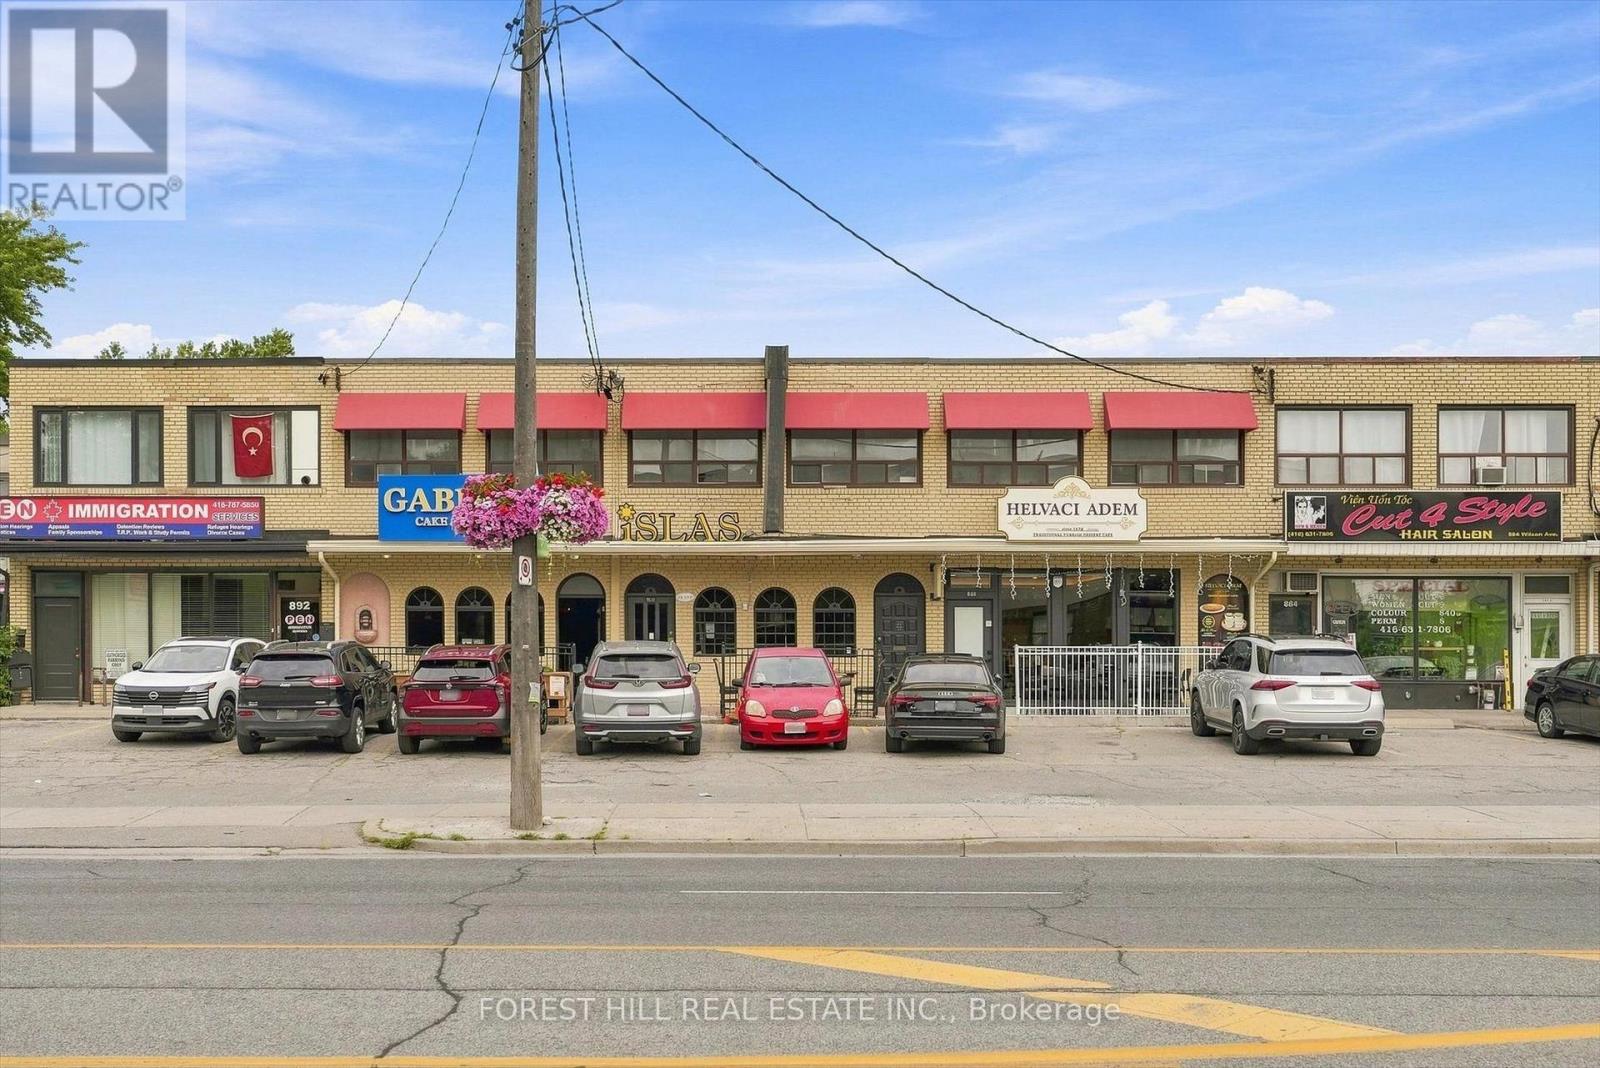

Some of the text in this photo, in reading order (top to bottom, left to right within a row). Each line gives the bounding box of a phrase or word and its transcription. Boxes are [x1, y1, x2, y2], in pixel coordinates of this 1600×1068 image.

[0, 499, 209, 519] EN IMMIGRATION
[1007, 503, 1138, 516] HELVACI ADEM
[212, 512, 260, 521] SERVICES
[1341, 494, 1548, 536] Cut 4 Style
[415, 517, 449, 526] CAKE
[1401, 529, 1493, 540] HAIR SALON
[289, 601, 311, 610] 892
[1370, 609, 1407, 617] COLOUR
[285, 614, 315, 625] PEN
[1380, 625, 1451, 633] 416-631-7806
